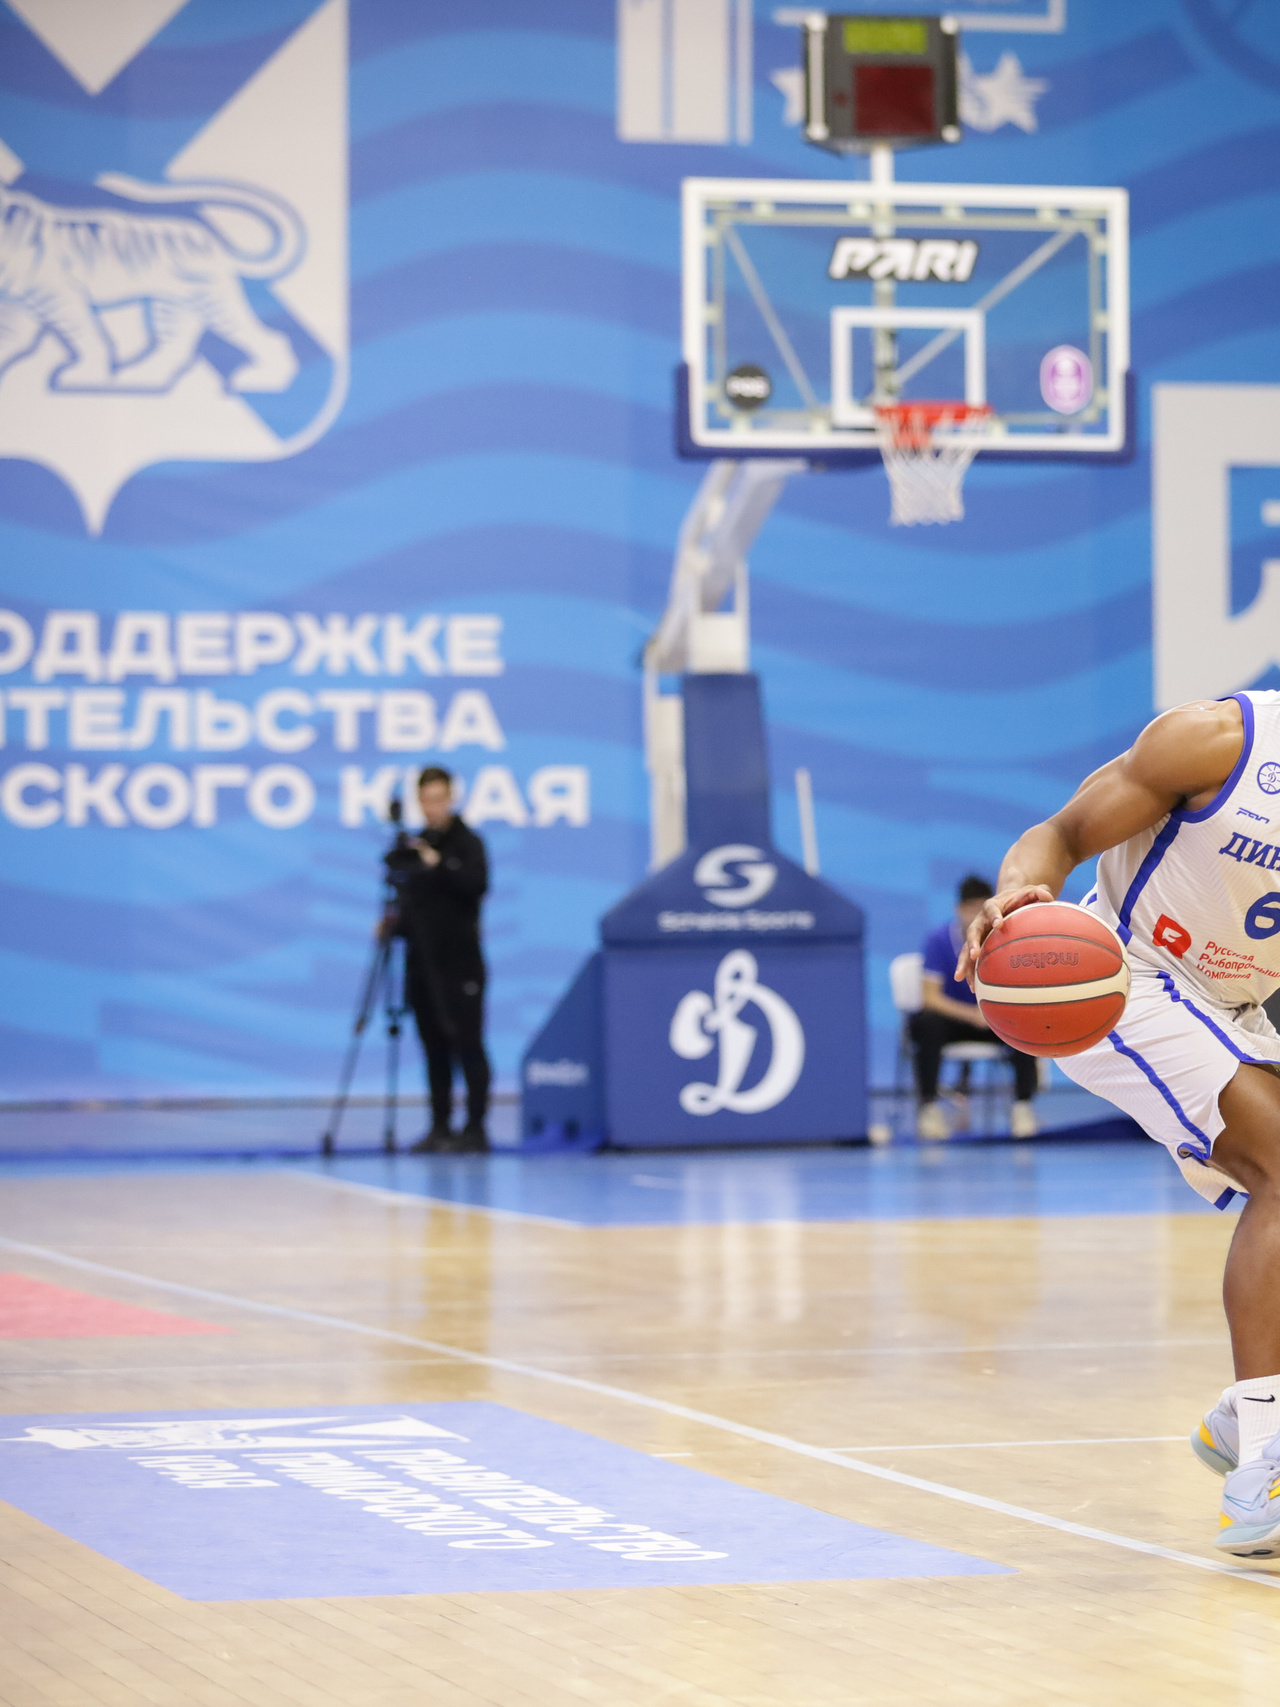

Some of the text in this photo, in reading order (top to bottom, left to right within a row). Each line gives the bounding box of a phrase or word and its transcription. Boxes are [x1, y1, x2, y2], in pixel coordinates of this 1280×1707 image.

[829, 237, 979, 282] PARI
[0, 687, 507, 753] ТЕЛЬСТВА
[1009, 952, 1079, 969] molten
[127, 1454, 281, 1489] КРАЯ
[240, 1452, 556, 1550] ПРИМОРСКОГО
[352, 1449, 729, 1562] ПРАВИТЕЛЬСТВО
